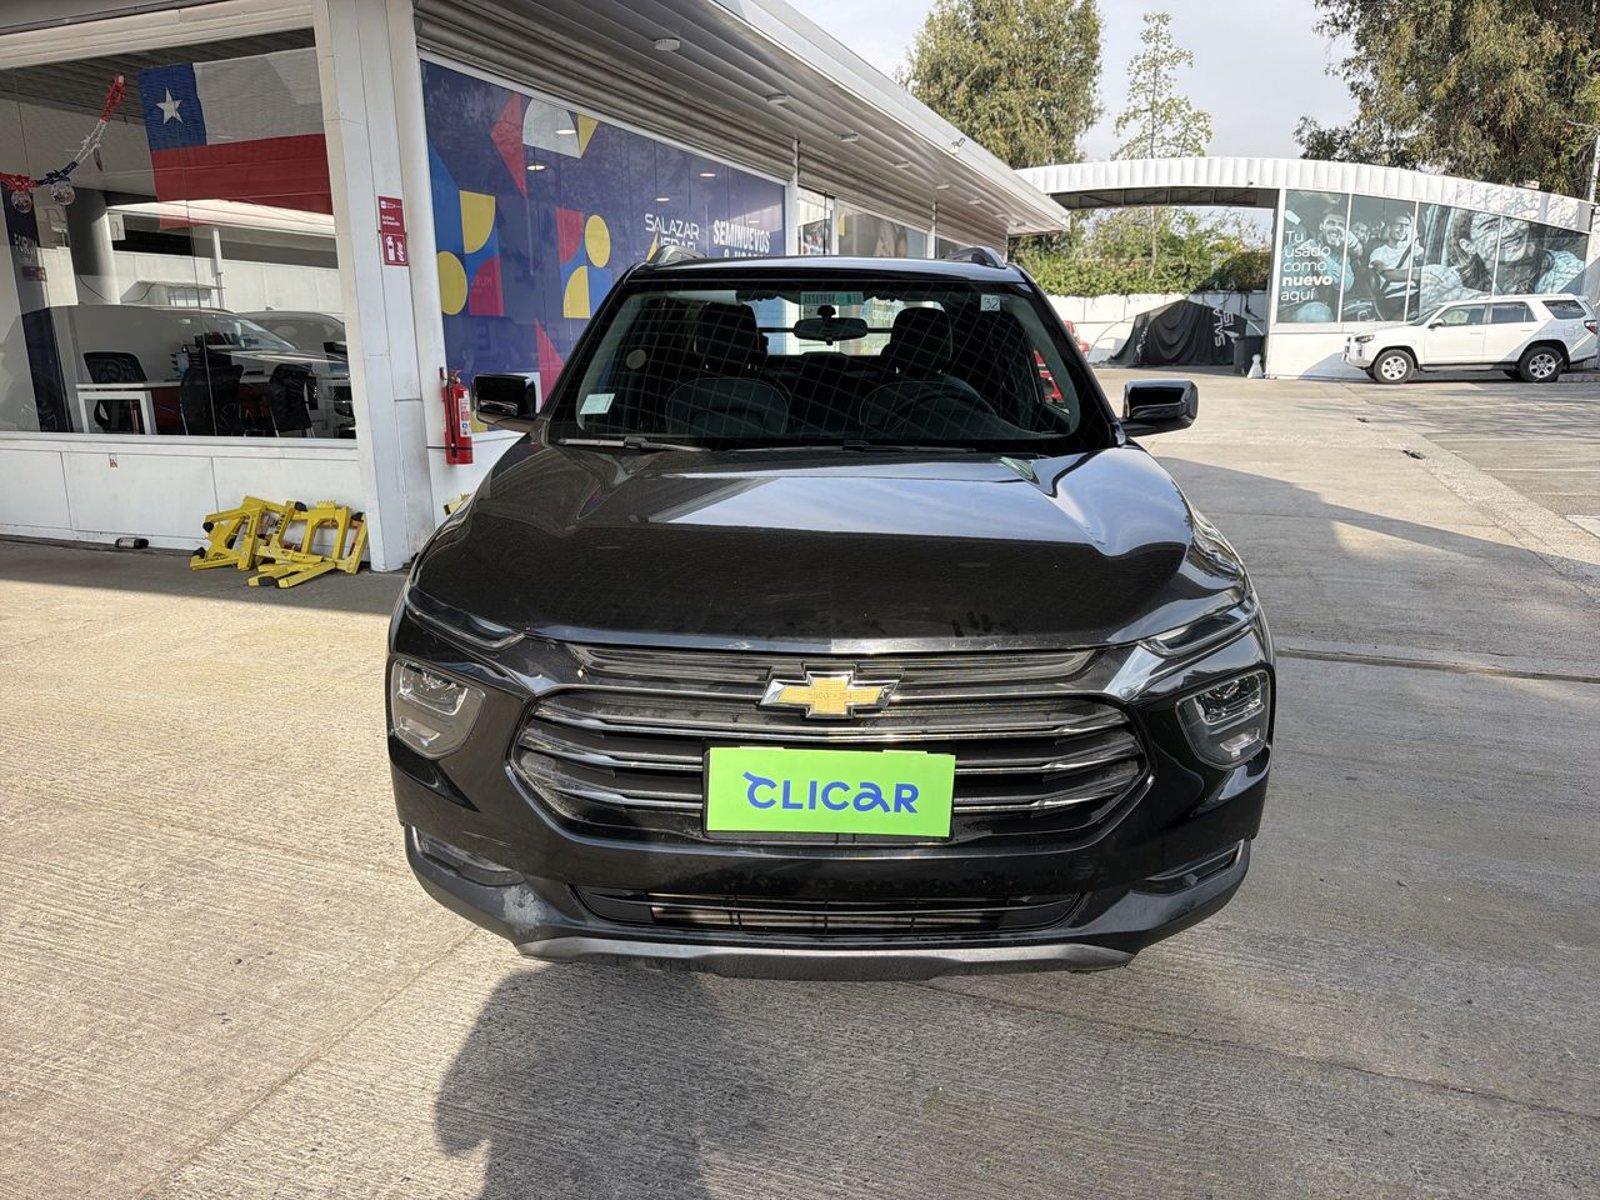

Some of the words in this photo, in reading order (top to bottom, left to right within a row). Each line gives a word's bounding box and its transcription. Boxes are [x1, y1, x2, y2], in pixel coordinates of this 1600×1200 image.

[645, 213, 700, 241] SALAZAR
[713, 219, 771, 254] SEMINUEVOS
[1285, 230, 1304, 243] Tu
[1284, 243, 1331, 257] usado
[1283, 261, 1328, 272] como
[1282, 275, 1333, 286] nuevo
[1280, 288, 1316, 303] aquí
